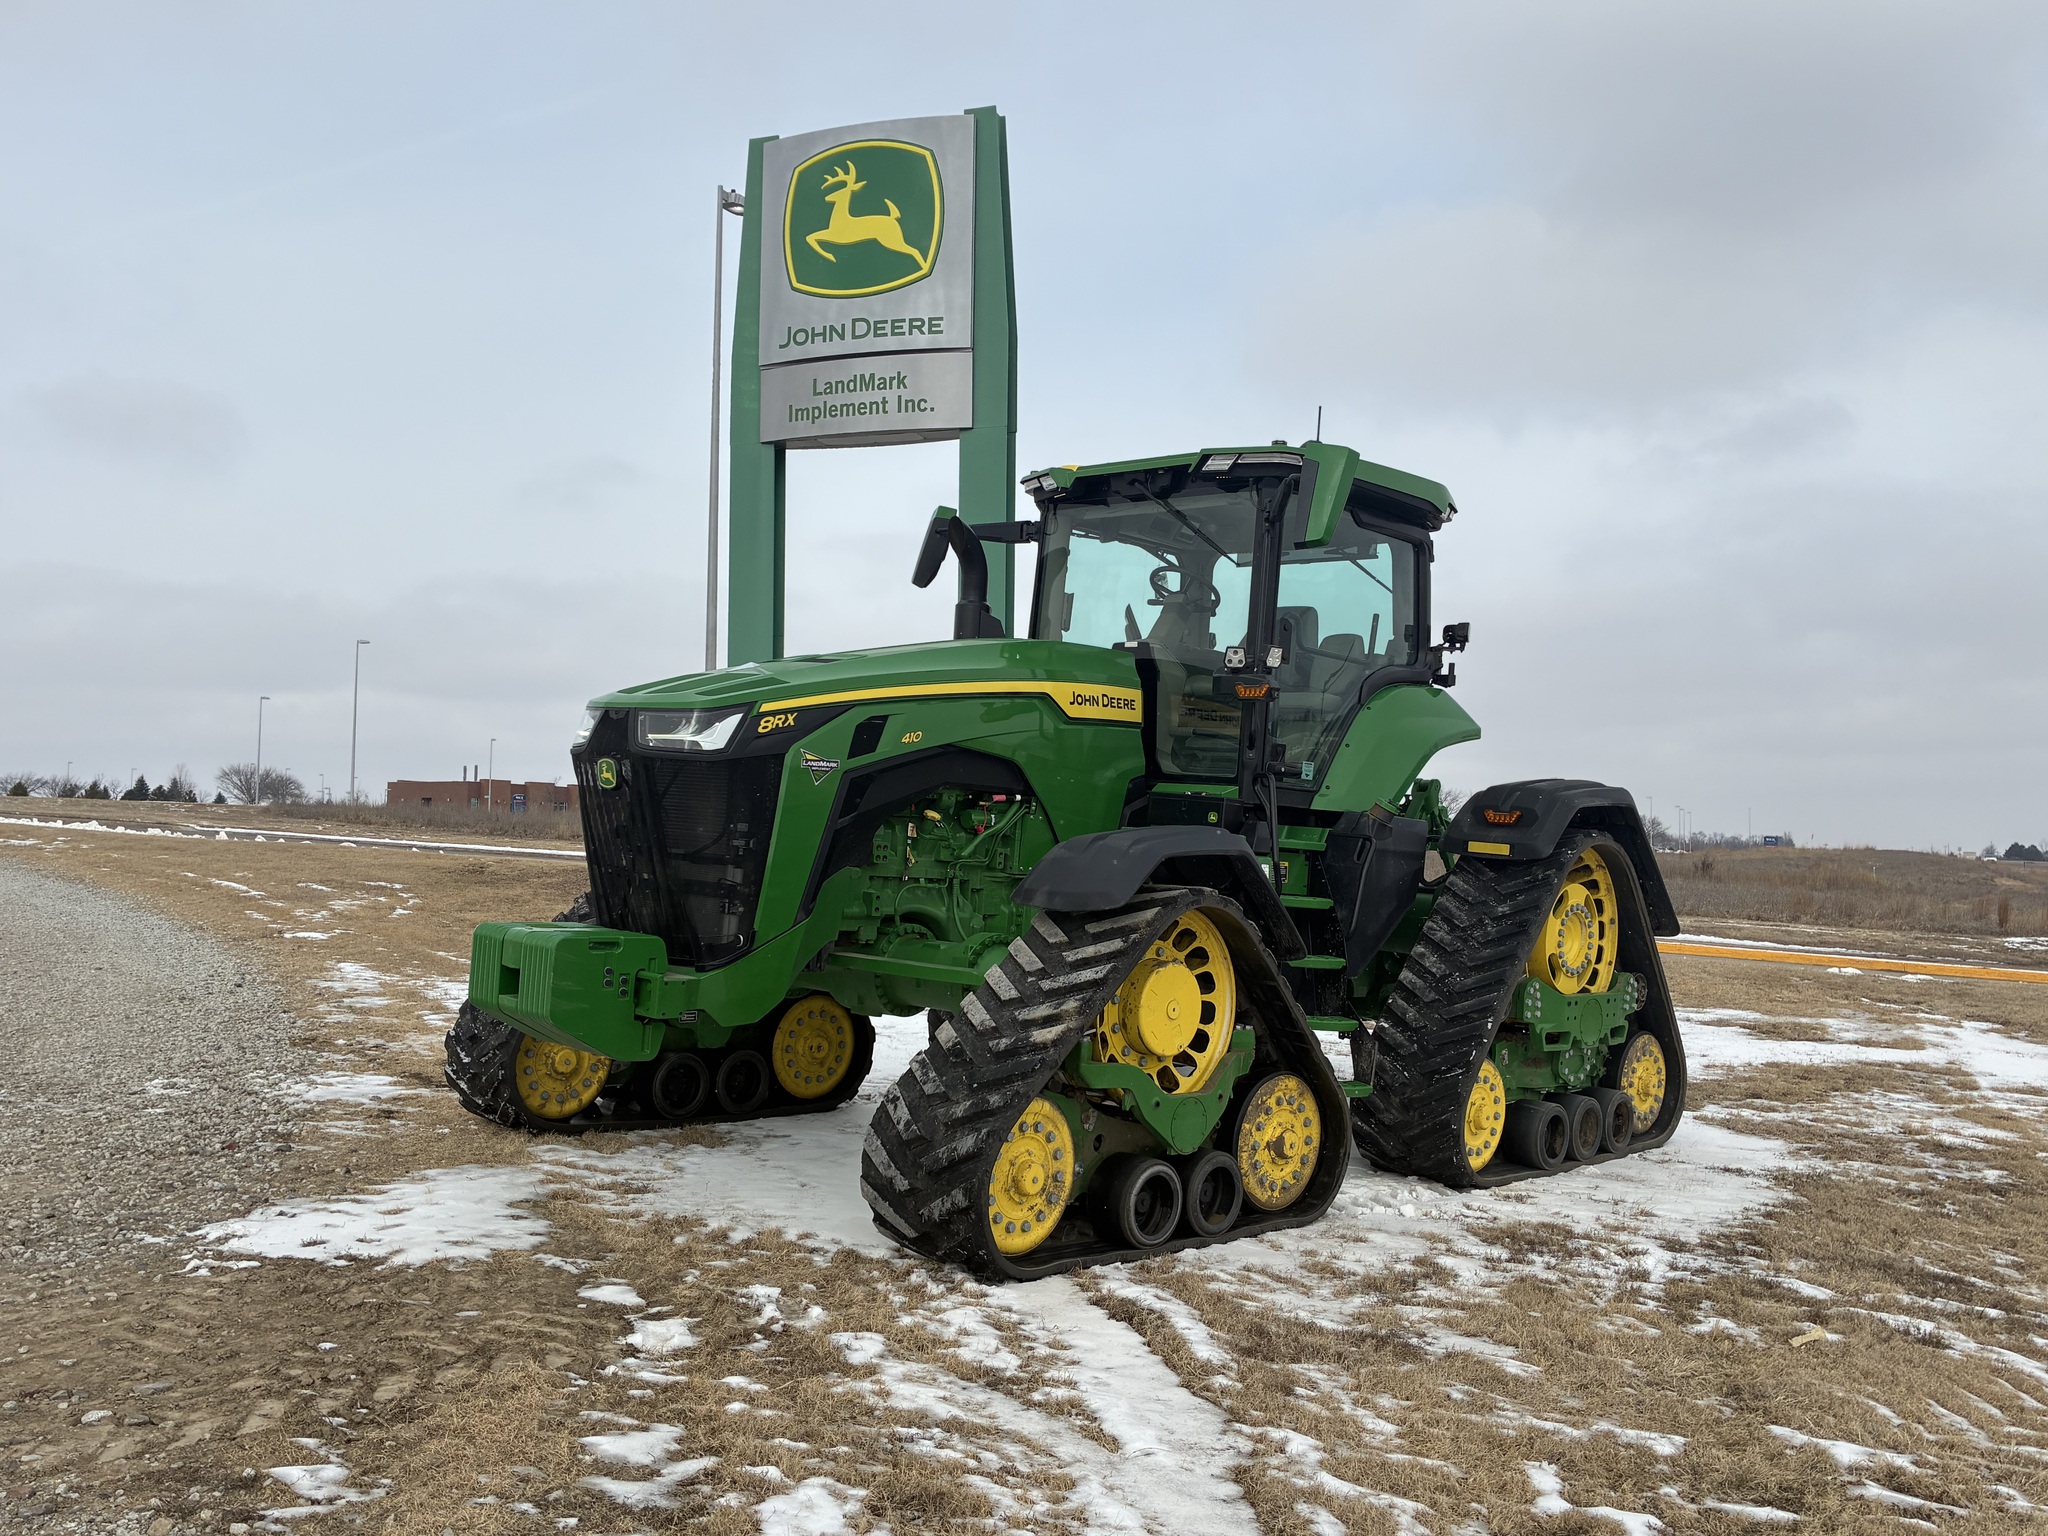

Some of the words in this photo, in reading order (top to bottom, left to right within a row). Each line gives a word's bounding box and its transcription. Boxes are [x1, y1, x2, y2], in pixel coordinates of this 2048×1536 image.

[779, 323, 846, 349] JOHN
[851, 316, 944, 340] DEERE
[812, 371, 908, 397] LandMark
[788, 396, 889, 424] Implement
[897, 395, 935, 414] Inc.
[1069, 691, 1099, 707] JOHN
[1101, 693, 1136, 711] DEERE
[757, 712, 798, 733] 8RX
[900, 731, 923, 744] 410
